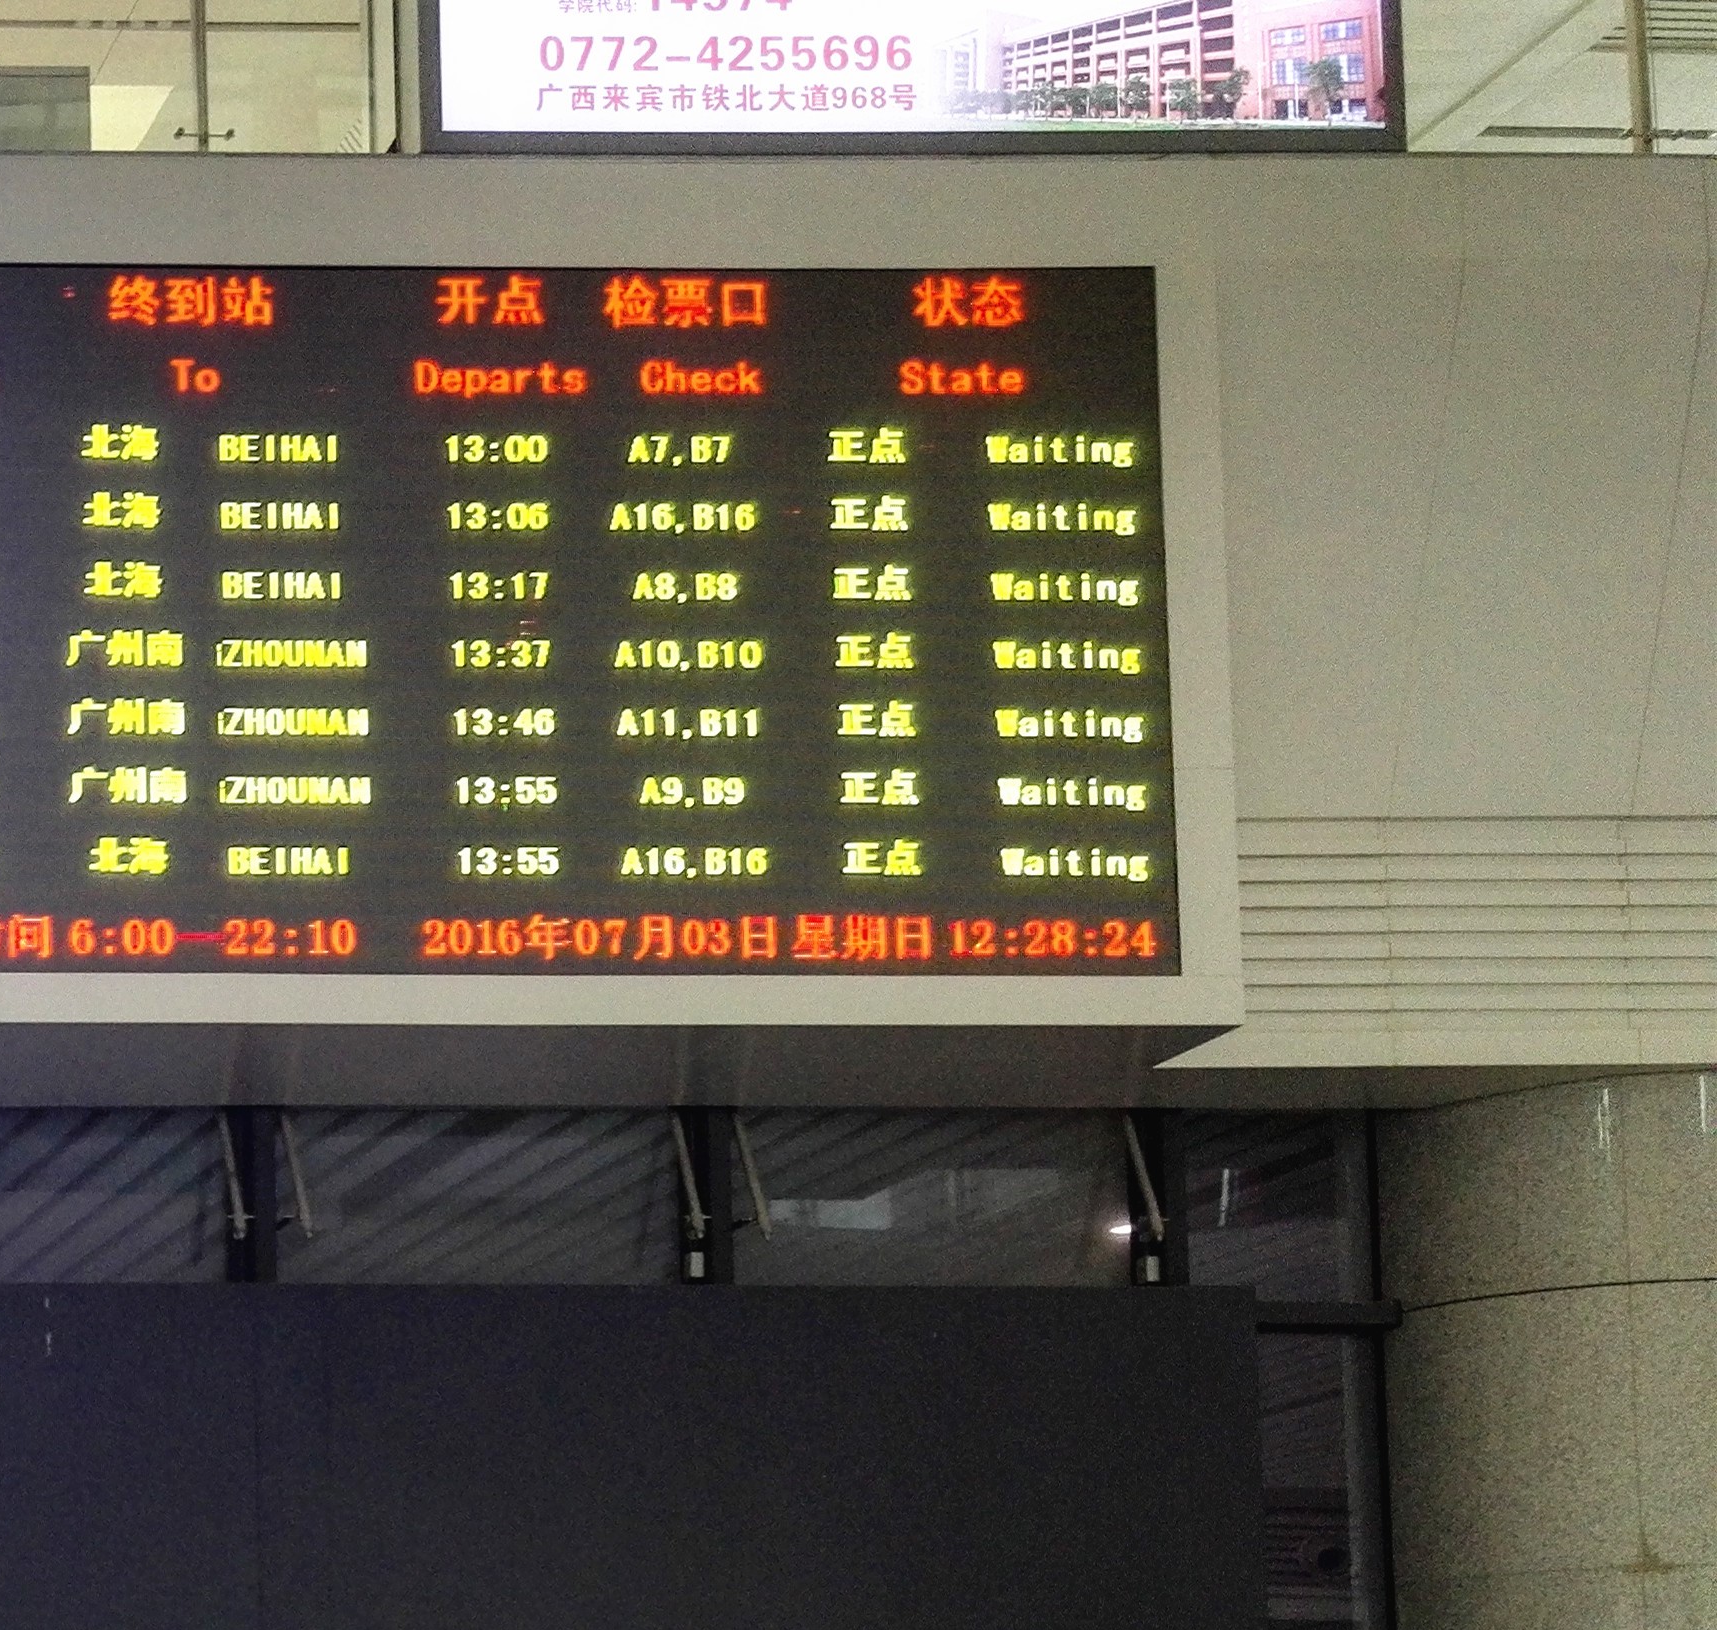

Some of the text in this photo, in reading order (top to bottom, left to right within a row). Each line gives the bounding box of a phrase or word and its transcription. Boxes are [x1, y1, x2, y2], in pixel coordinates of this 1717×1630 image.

[539, 35, 913, 71] 0772-4255696
[536, 83, 917, 111] 广西来宾市铁北大道968号
[109, 276, 274, 328] 终到站
[437, 275, 546, 326] 开点
[604, 276, 768, 330] 检票口
[914, 277, 1025, 329] 状态
[171, 359, 222, 394] To
[414, 360, 587, 400] Departs
[640, 360, 763, 396] Check
[900, 360, 1026, 396] State
[81, 424, 161, 462] 北海
[219, 435, 338, 463] BEIHAI
[446, 435, 550, 464] 13:00
[628, 436, 732, 468] A7,B7
[828, 427, 908, 465] 正点
[986, 436, 1135, 469] Waiting
[83, 492, 162, 530] 北海
[221, 502, 340, 531] BEIHAI
[447, 503, 550, 531] 13:06
[610, 503, 757, 535] A16,B16
[831, 495, 910, 532] 正点
[988, 503, 1138, 537] Waiting
[84, 562, 164, 600] 北海
[222, 572, 342, 601] BEIHAI
[450, 572, 550, 601] 13:17
[633, 572, 740, 605] A8,B8
[833, 564, 914, 602] 正点
[990, 573, 1140, 608] Waiting
[66, 630, 185, 668] 广州南
[452, 640, 552, 669] 13:37
[615, 641, 764, 673] A10,B10
[836, 632, 916, 670] 正点
[993, 641, 1143, 676] Waiting
[68, 698, 187, 736] 广州南
[454, 708, 556, 737] 13:46
[617, 709, 759, 741] A11,B11
[838, 700, 918, 738] 正点
[995, 709, 1146, 744] Waiting
[69, 767, 189, 805] 广州南
[457, 777, 559, 805] 13:55
[640, 777, 746, 809] A9,B9
[841, 769, 921, 807] 正点
[998, 778, 1148, 812] Waiting
[89, 837, 170, 876] 北海
[228, 847, 350, 876] BEIHAI
[458, 847, 561, 876] 13:55
[621, 848, 769, 880] A16,B16
[843, 839, 923, 877] 正点
[1001, 848, 1150, 883] Waiting
[422, 914, 780, 962] 2016年07月03日
[791, 914, 934, 963] 星期日
[949, 920, 1158, 960] 12:28:24
